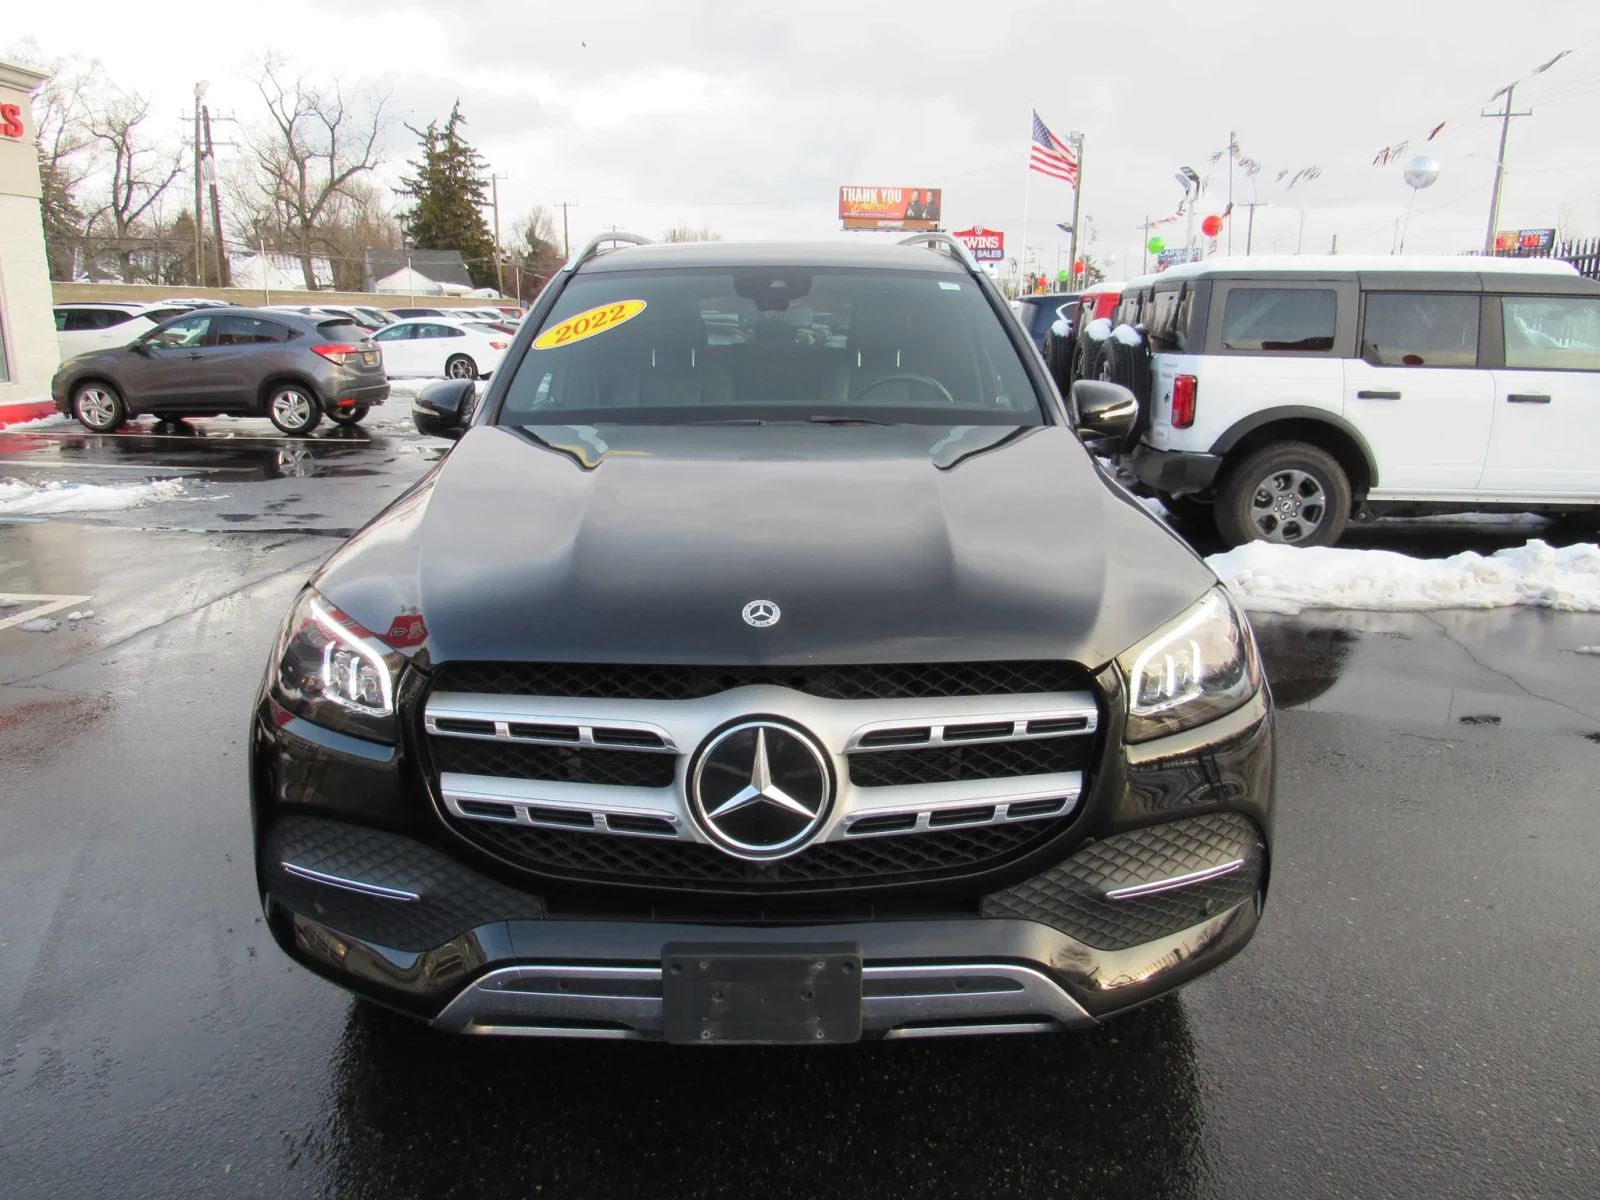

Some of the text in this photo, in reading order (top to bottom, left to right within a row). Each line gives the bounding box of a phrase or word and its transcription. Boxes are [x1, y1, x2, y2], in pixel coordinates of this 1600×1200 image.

[842, 187, 902, 203] THANK YOU
[555, 304, 626, 344] 2022
